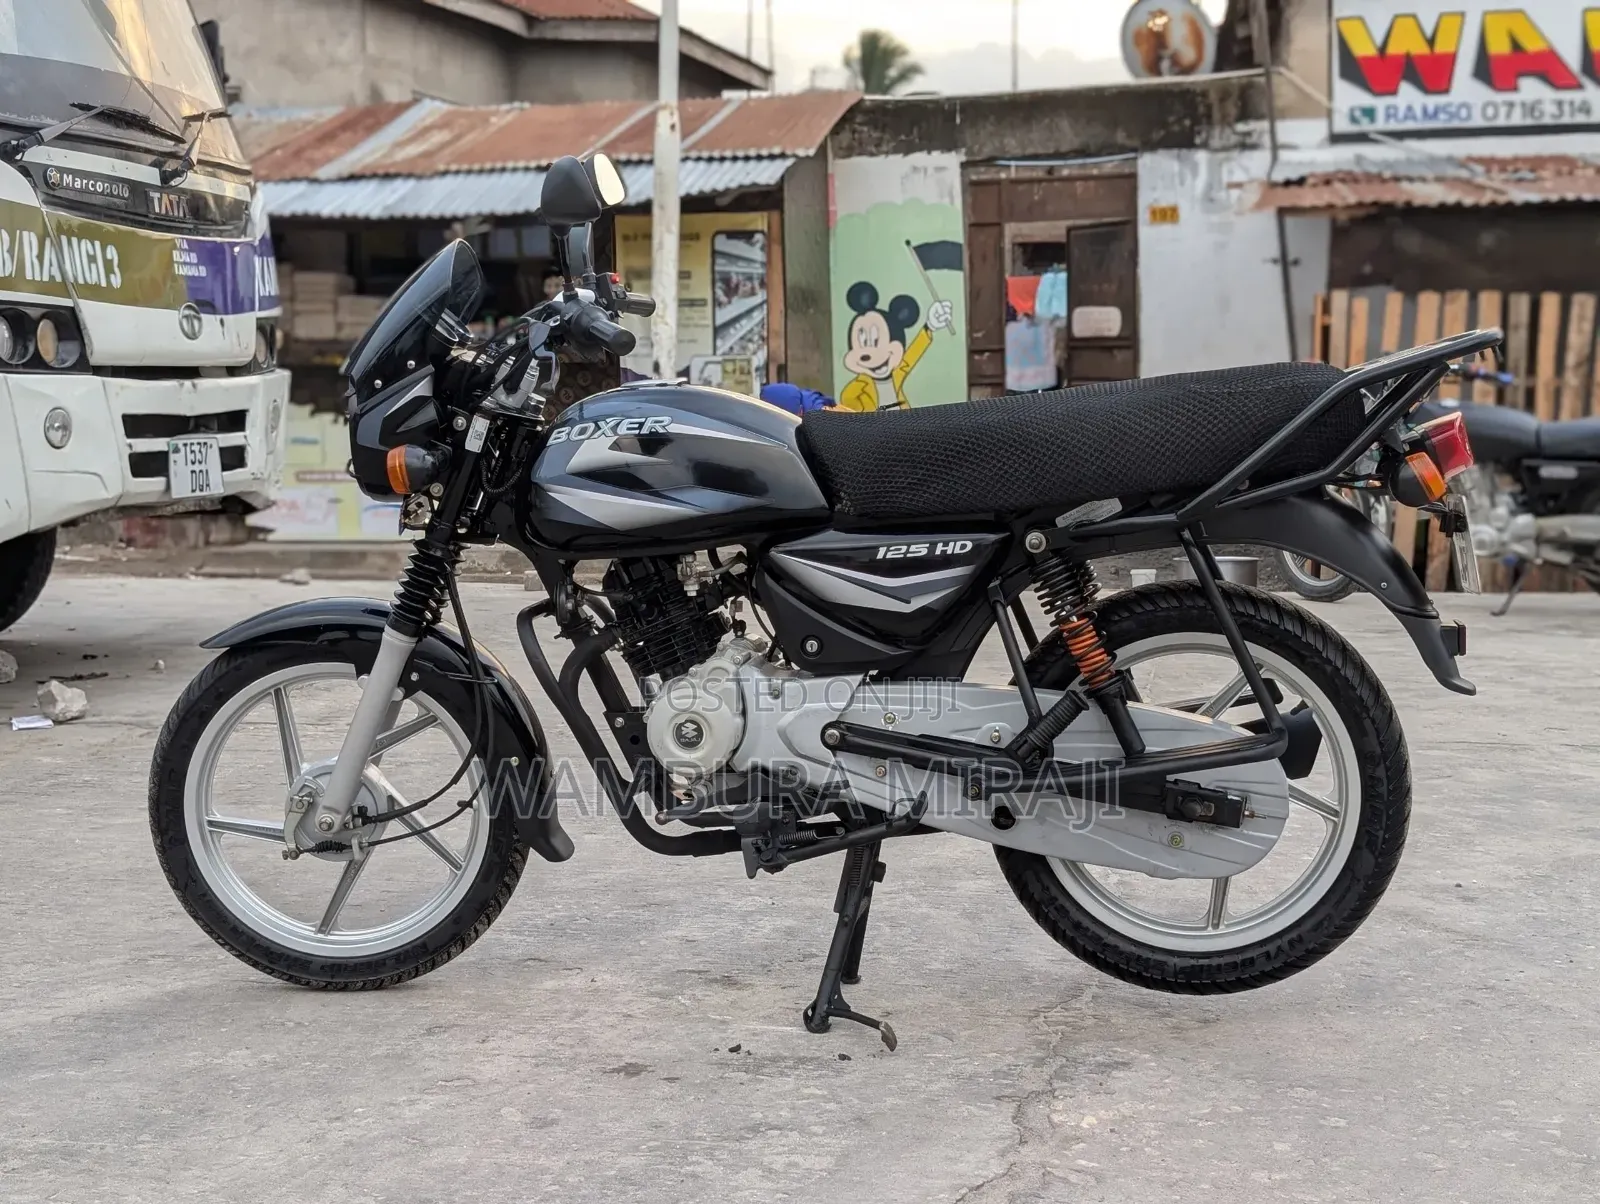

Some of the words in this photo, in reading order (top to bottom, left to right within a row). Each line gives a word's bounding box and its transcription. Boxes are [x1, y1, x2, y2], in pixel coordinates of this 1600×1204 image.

[1336, 8, 1600, 96] WA
[1384, 102, 1474, 123] RAMSO
[62, 172, 130, 198] Marcopolo
[149, 190, 190, 219] TATA
[546, 416, 673, 447] BOXER
[182, 441, 209, 466] T537
[876, 543, 930, 559] 125
[934, 540, 973, 556] HD
